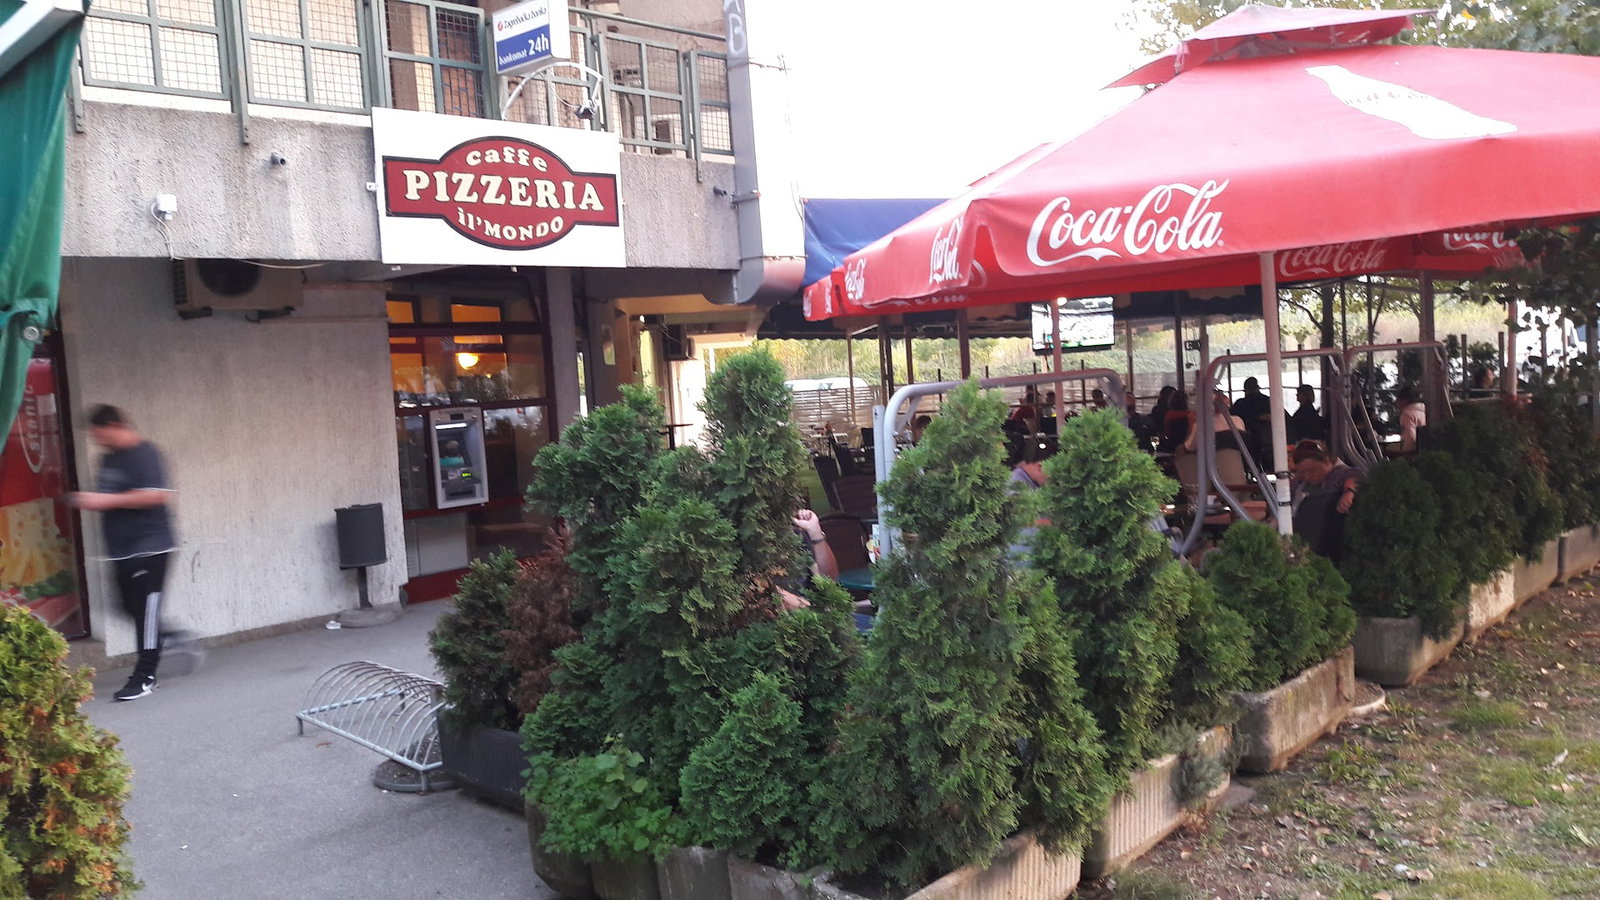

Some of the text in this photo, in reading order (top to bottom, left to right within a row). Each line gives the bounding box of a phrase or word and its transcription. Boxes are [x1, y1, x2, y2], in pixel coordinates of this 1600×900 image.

[527, 33, 549, 56] 24h
[466, 146, 548, 172] caffe
[402, 169, 604, 212] PIZZERIA
[456, 207, 564, 241] il'MONDO
[1026, 178, 1230, 267] Coca-Cola
